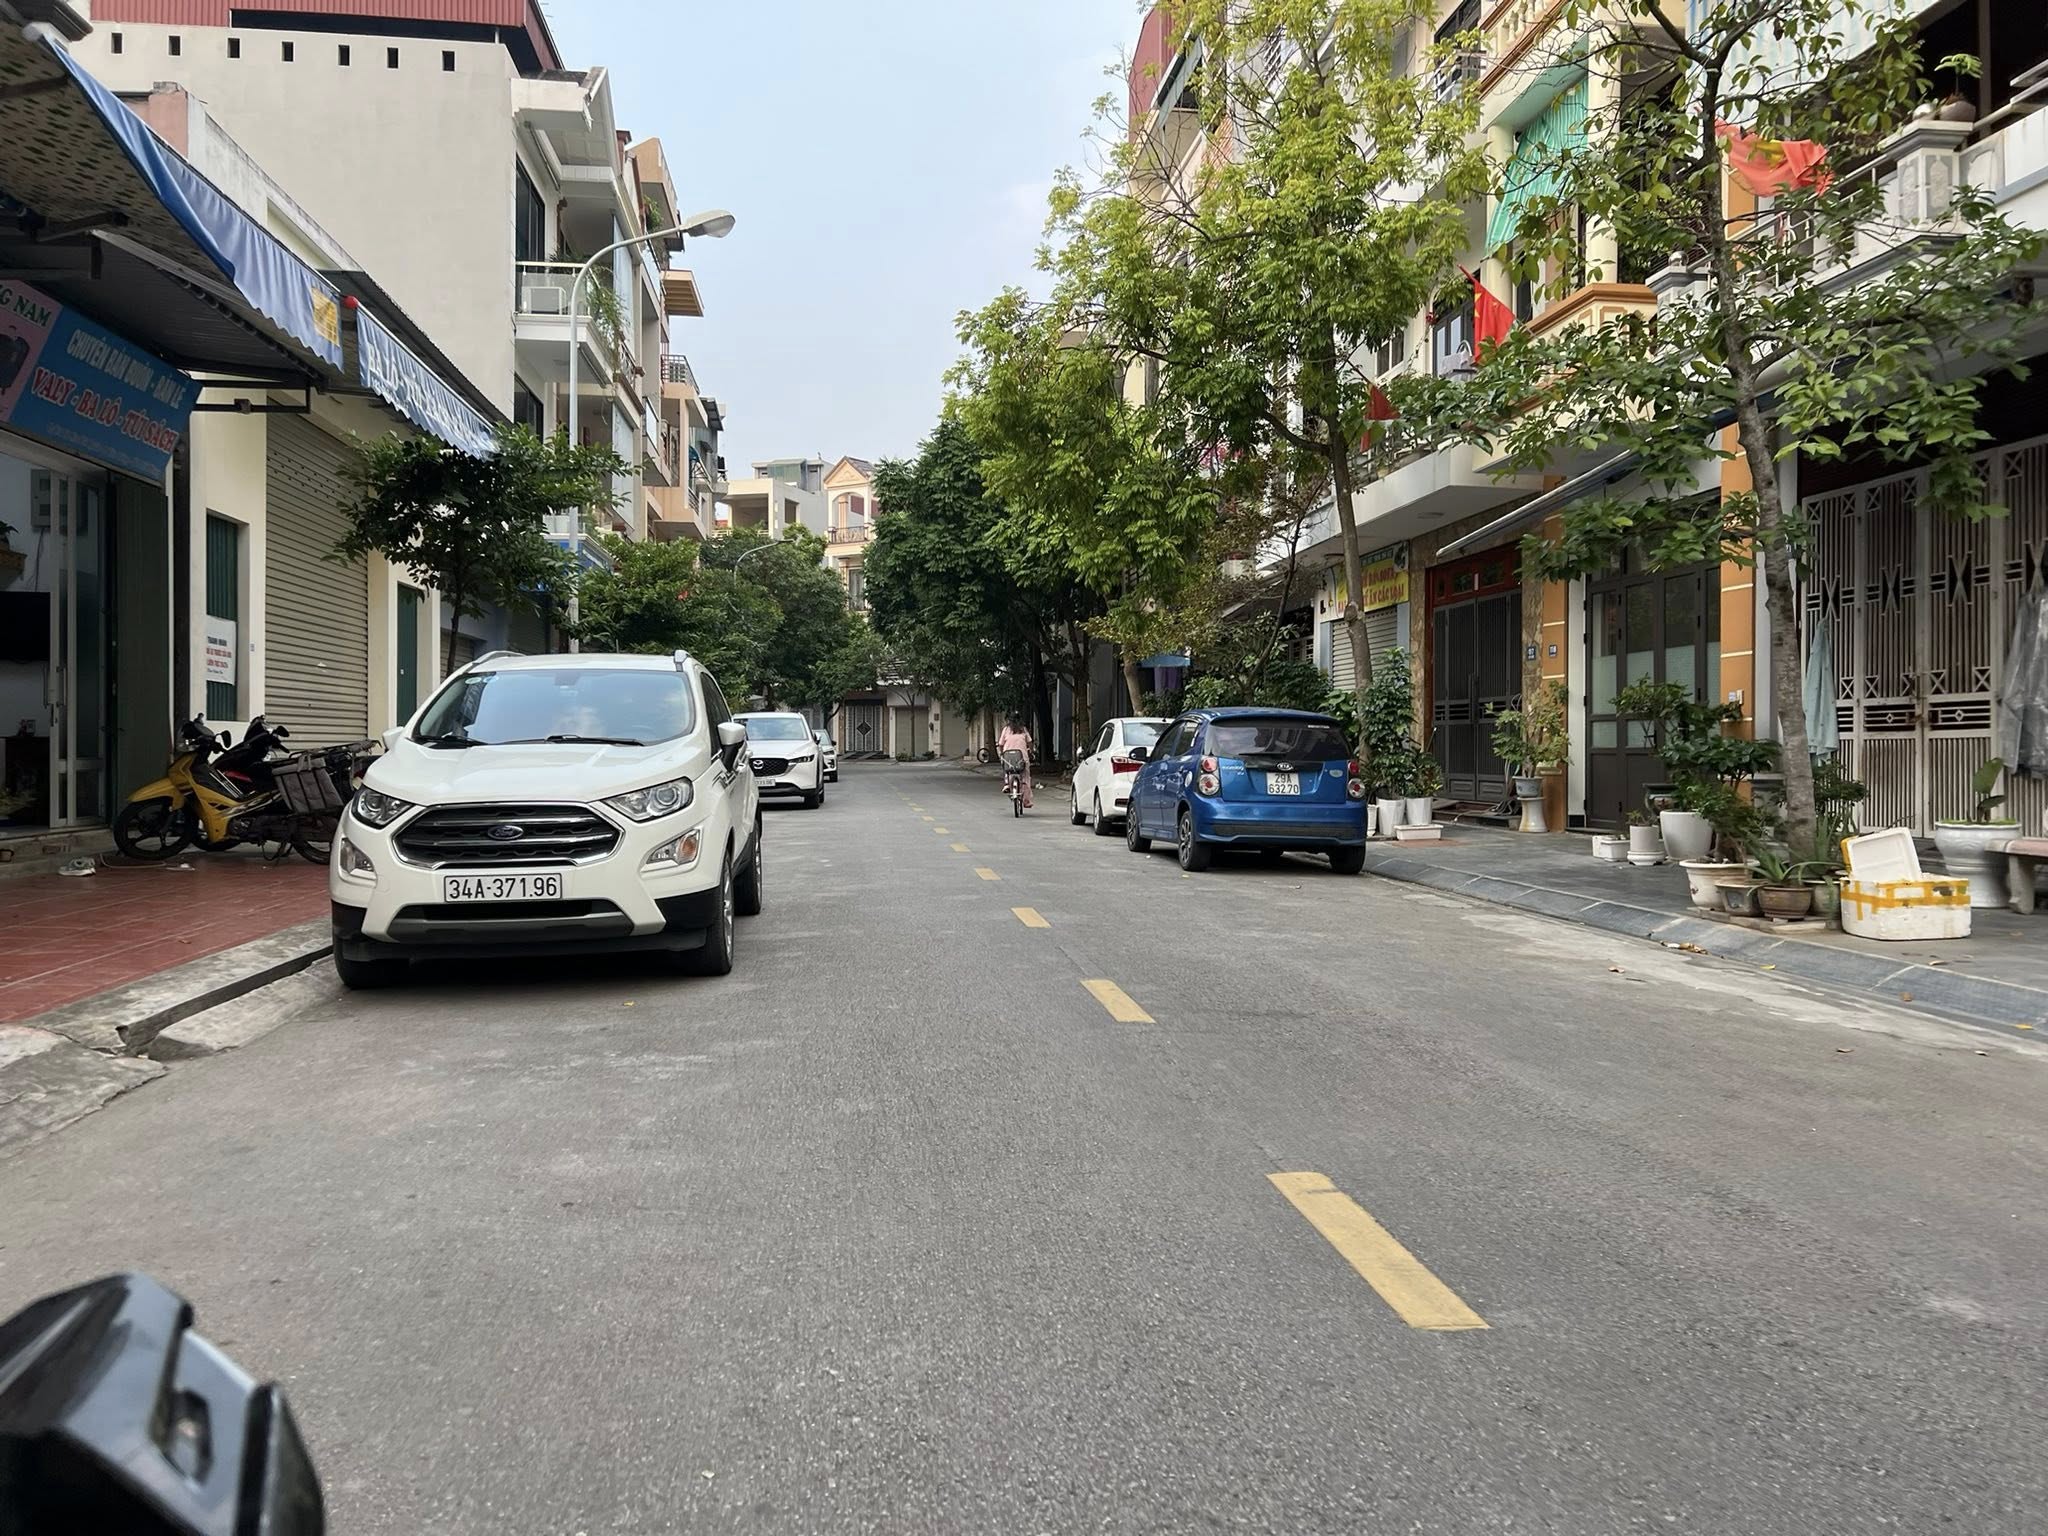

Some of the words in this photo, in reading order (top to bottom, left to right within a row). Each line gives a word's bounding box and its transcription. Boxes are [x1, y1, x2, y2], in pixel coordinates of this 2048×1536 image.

[13, 295, 52, 327] NAM
[31, 366, 77, 407] VALY
[75, 388, 101, 420] BA
[96, 397, 123, 428] LÔ
[1275, 773, 1292, 783] 29A
[449, 876, 557, 899] 34A-371.96
